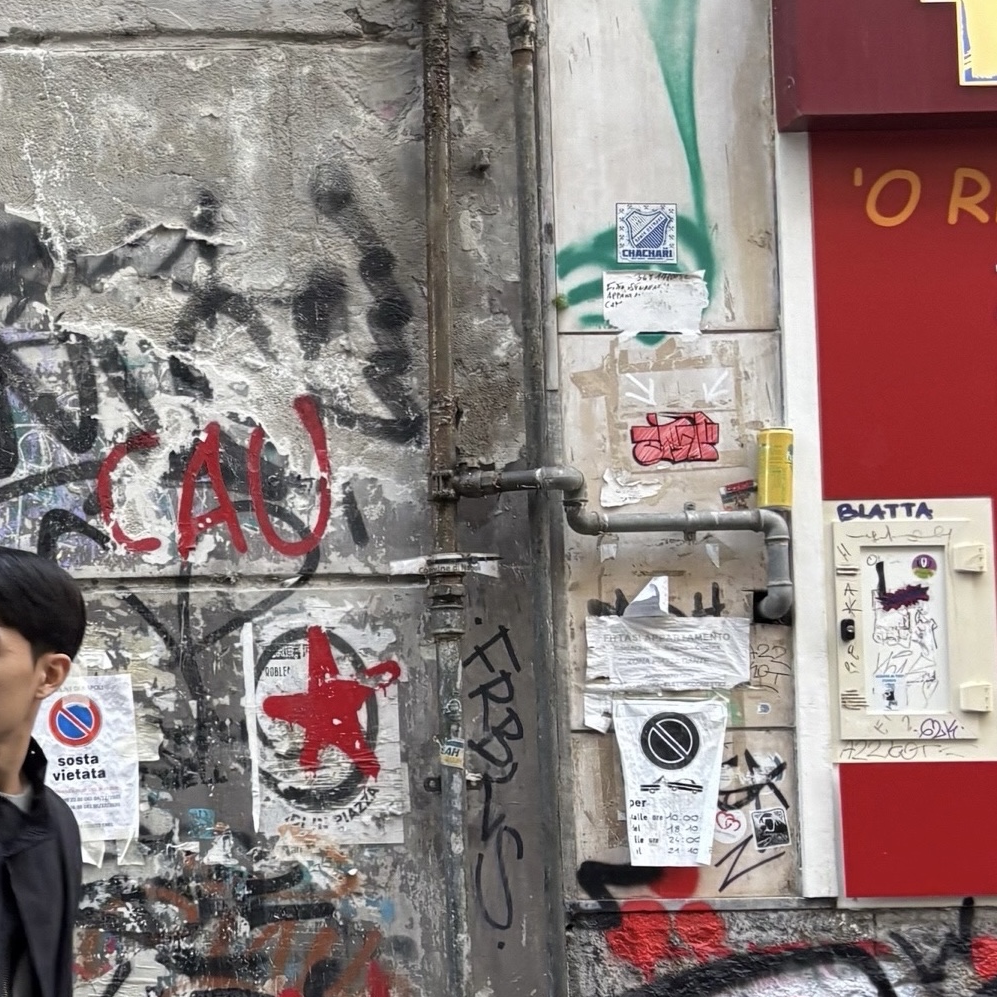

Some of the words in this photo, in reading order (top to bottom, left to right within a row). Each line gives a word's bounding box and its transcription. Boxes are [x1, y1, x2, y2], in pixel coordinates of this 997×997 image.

[853, 167, 922, 227] 'O
[947, 167, 997, 225] R
[837, 502, 933, 522] BLATTA
[645, 632, 731, 642] APPARTAMENTO
[57, 753, 99, 767] sosta
[52, 768, 107, 781] vietata
